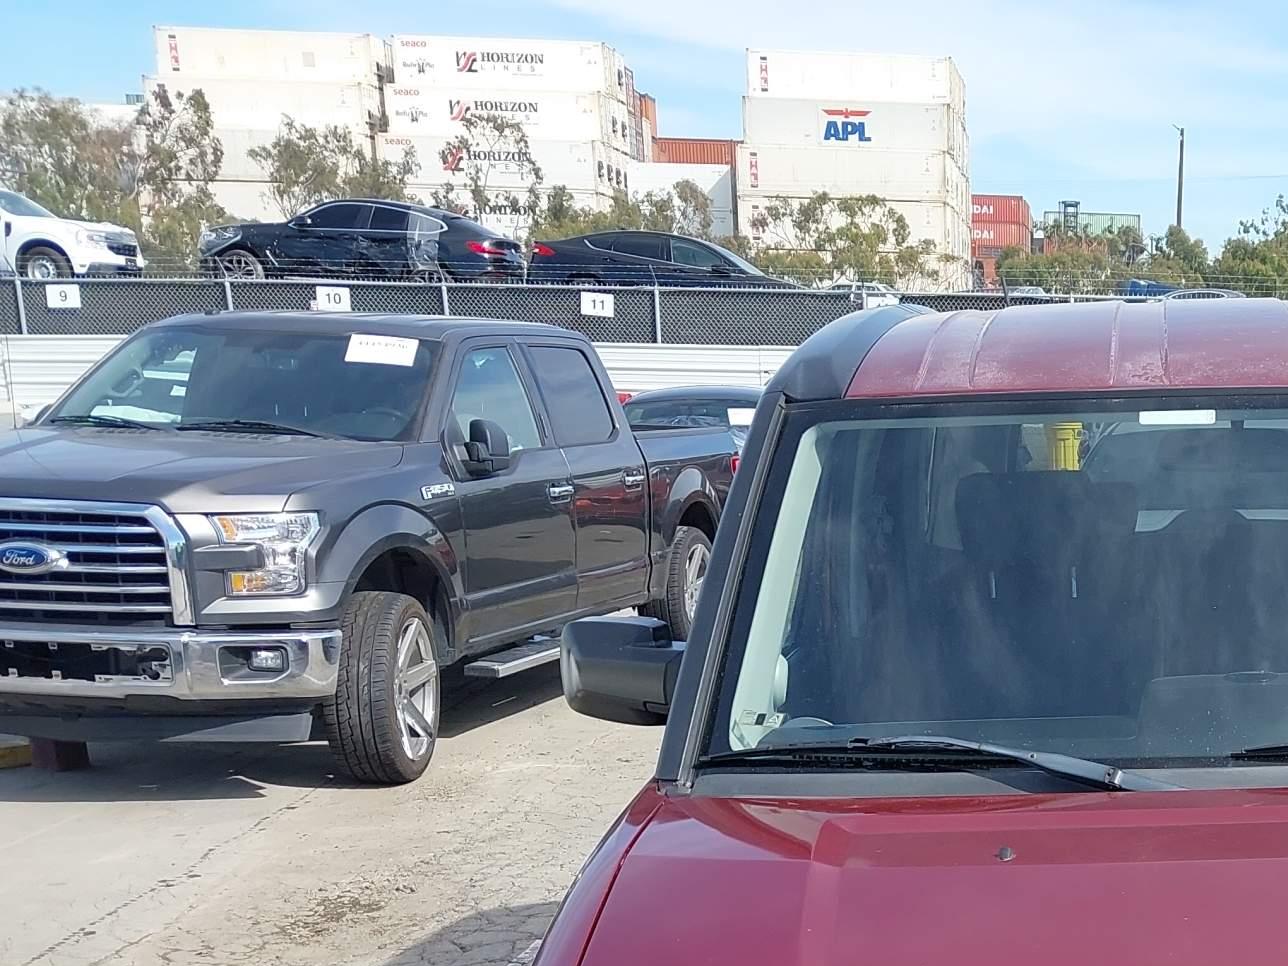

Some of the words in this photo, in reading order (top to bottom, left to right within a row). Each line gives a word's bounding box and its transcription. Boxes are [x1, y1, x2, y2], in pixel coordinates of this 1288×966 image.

[400, 40, 427, 48] seaco
[480, 51, 543, 64] HORIZON
[481, 63, 535, 72] LINES
[393, 88, 420, 96] seaco
[474, 100, 539, 113] HORIZON
[824, 120, 872, 142] APL
[384, 137, 412, 146] seaco
[466, 150, 531, 162] HORIZON
[59, 290, 68, 302] 9
[325, 292, 342, 305] 10
[591, 298, 605, 310] 11
[2, 549, 36, 565] Ford
